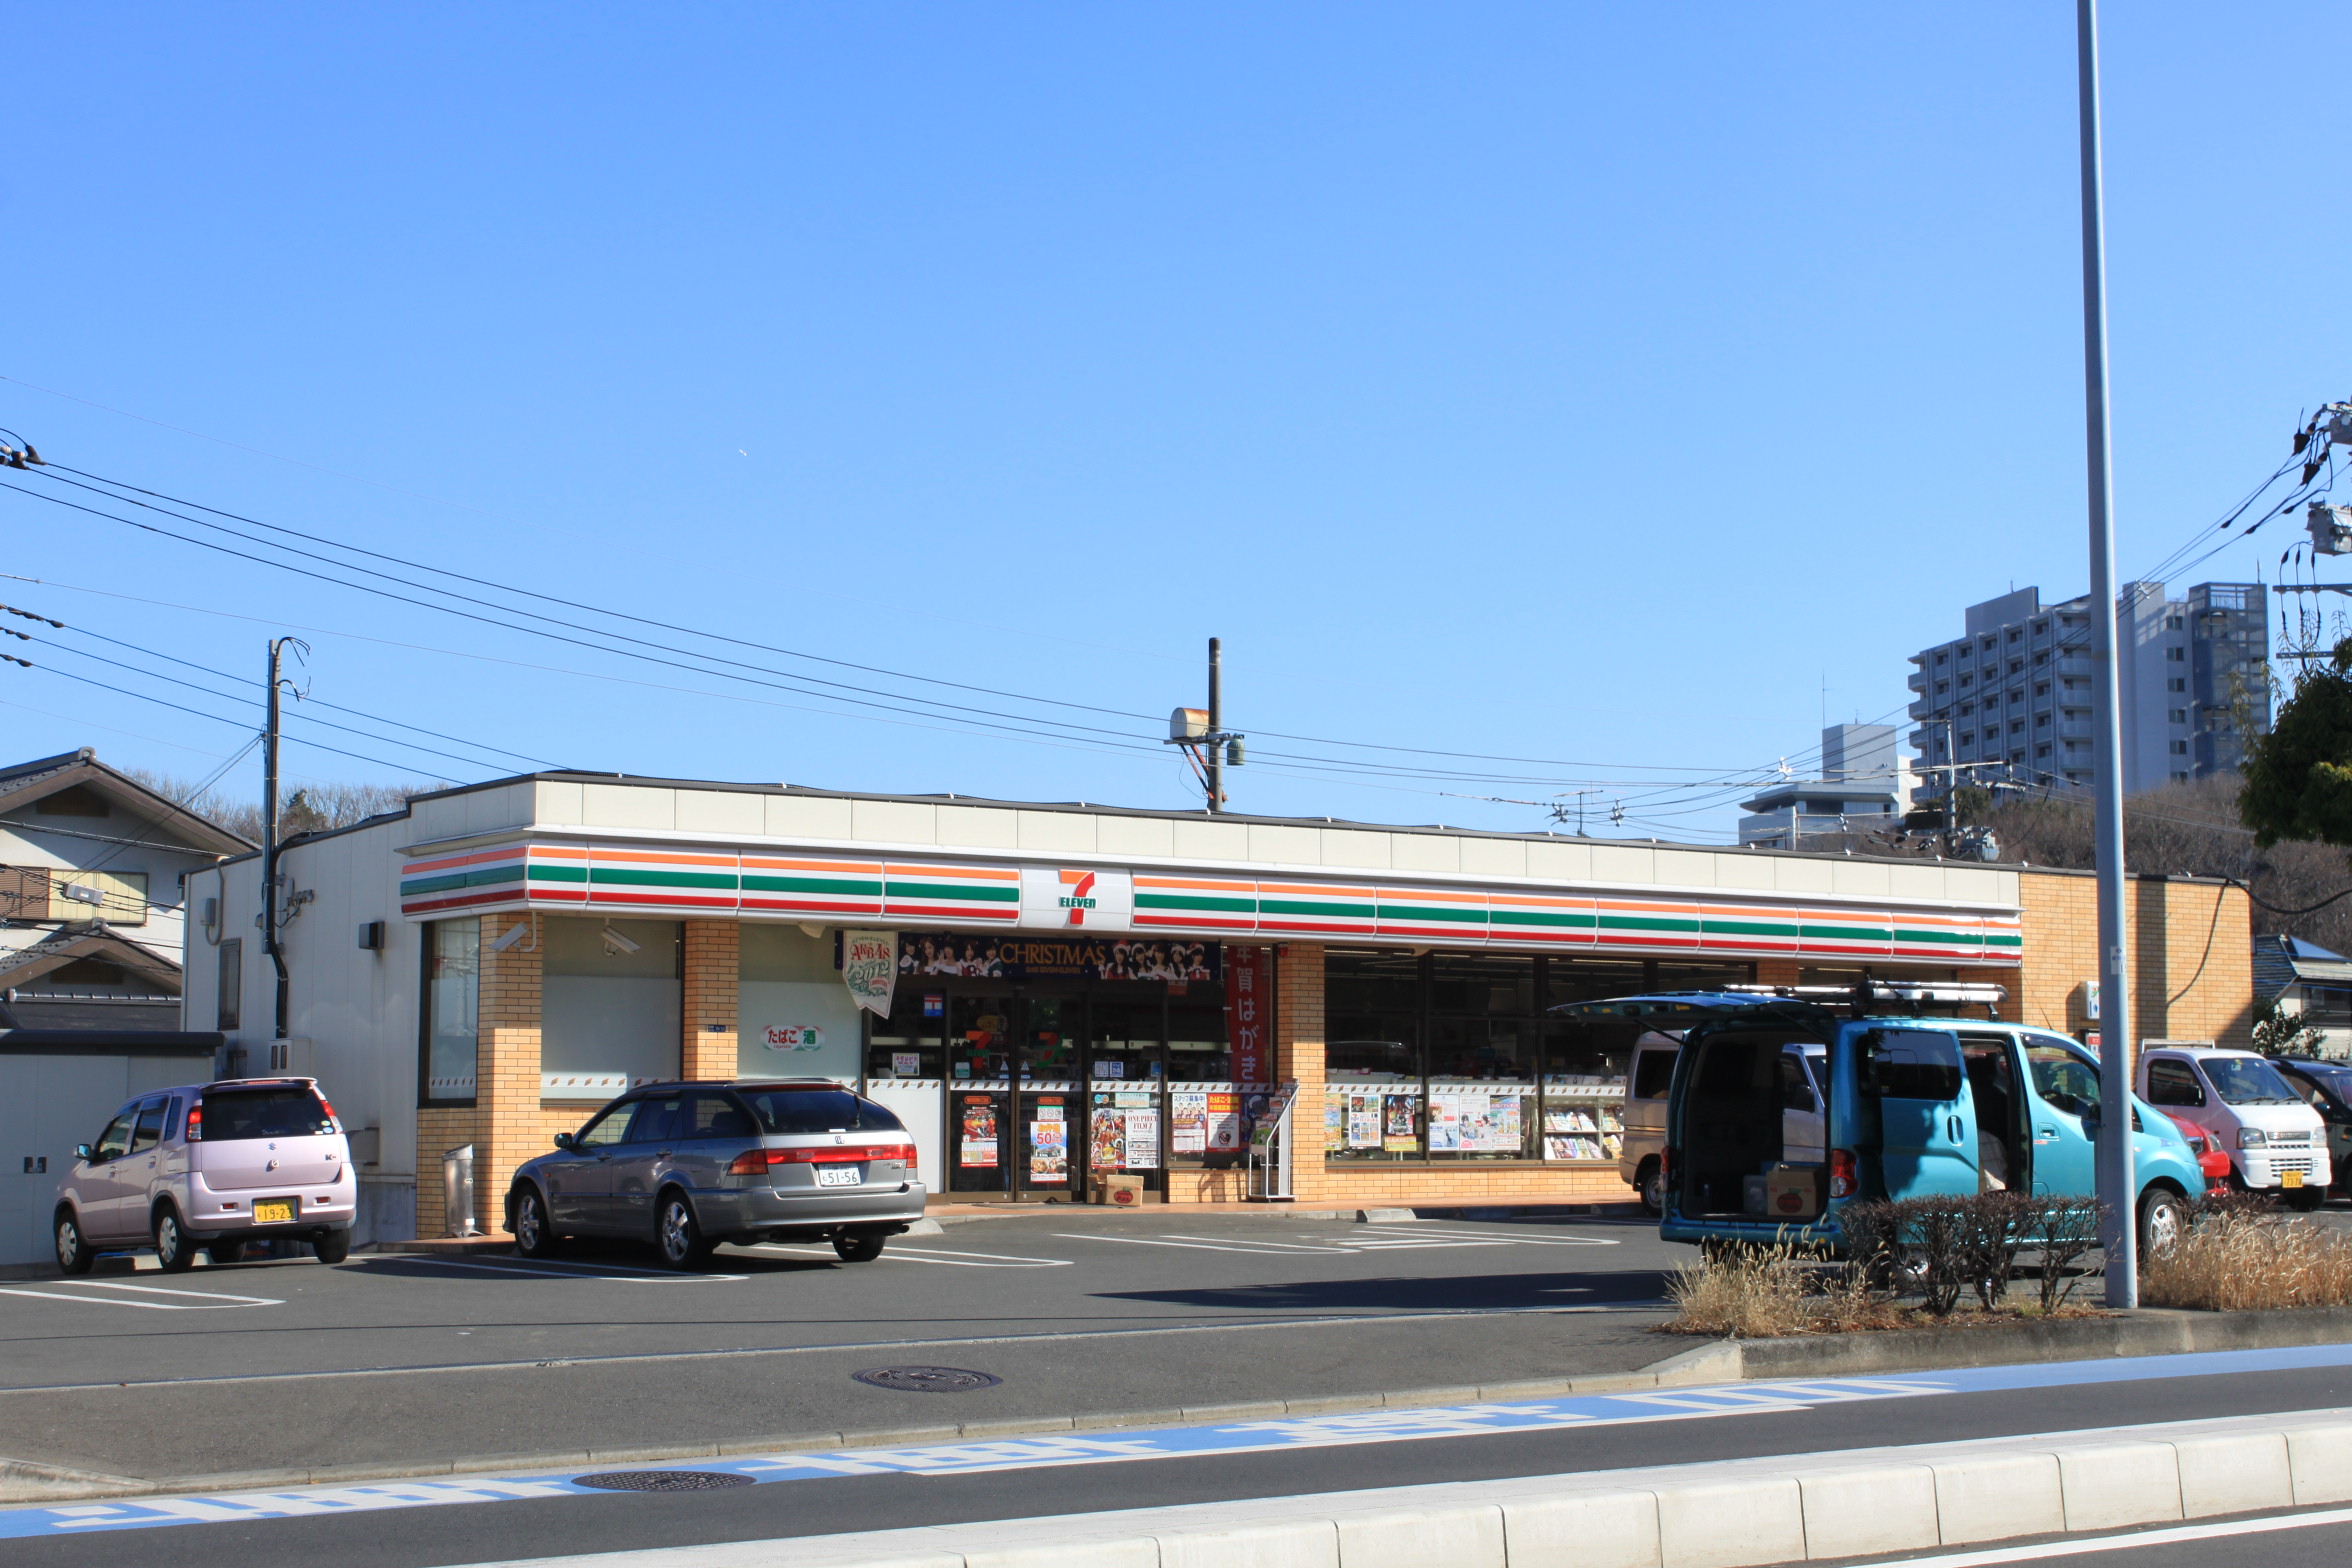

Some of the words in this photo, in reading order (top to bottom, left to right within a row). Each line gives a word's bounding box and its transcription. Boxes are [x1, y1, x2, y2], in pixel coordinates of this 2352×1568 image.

[1060, 870, 1095, 925] 7
[850, 944, 891, 961] AKB48
[1000, 943, 1105, 966] CHRISTMAS
[1236, 946, 1259, 1081] 年賀はがき
[767, 1028, 798, 1044] たばこ
[1036, 1132, 1052, 1145] 50
[828, 1172, 858, 1184] 51-56
